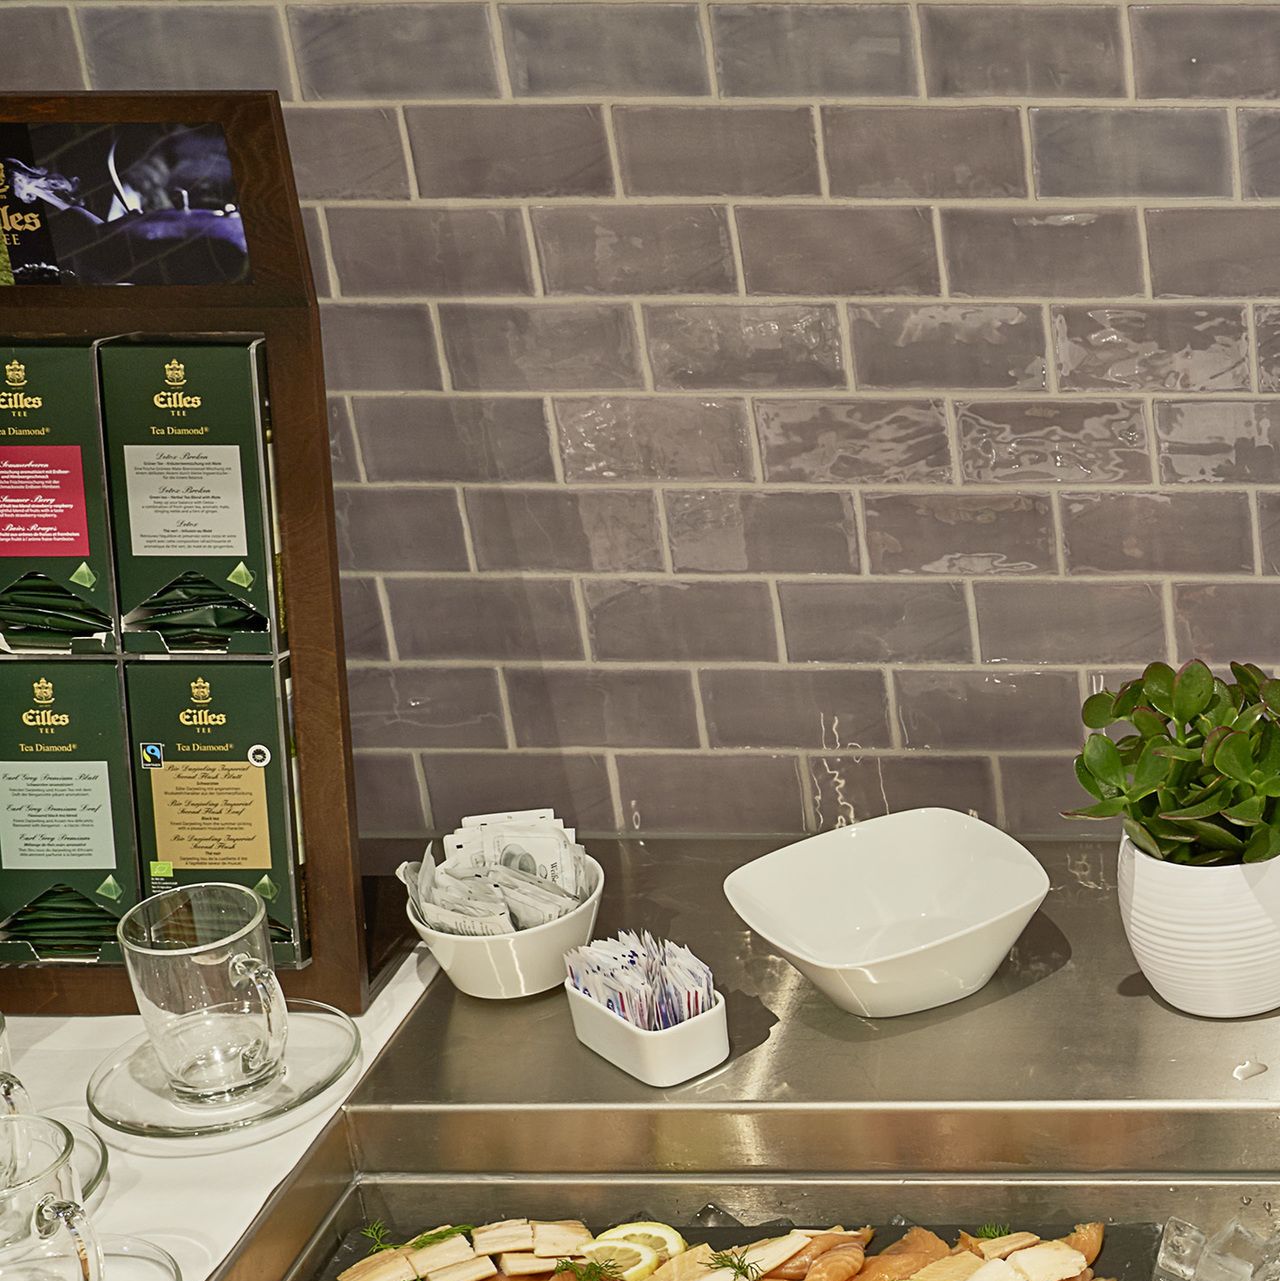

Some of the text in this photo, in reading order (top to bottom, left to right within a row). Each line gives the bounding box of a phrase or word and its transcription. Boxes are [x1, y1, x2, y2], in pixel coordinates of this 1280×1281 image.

[153, 391, 202, 409] Eilles
[150, 426, 165, 435] Tea
[21, 708, 70, 726] Eilles
[179, 708, 227, 726] Eilles
[19, 743, 34, 752] Tea
[176, 743, 191, 752] Tea
